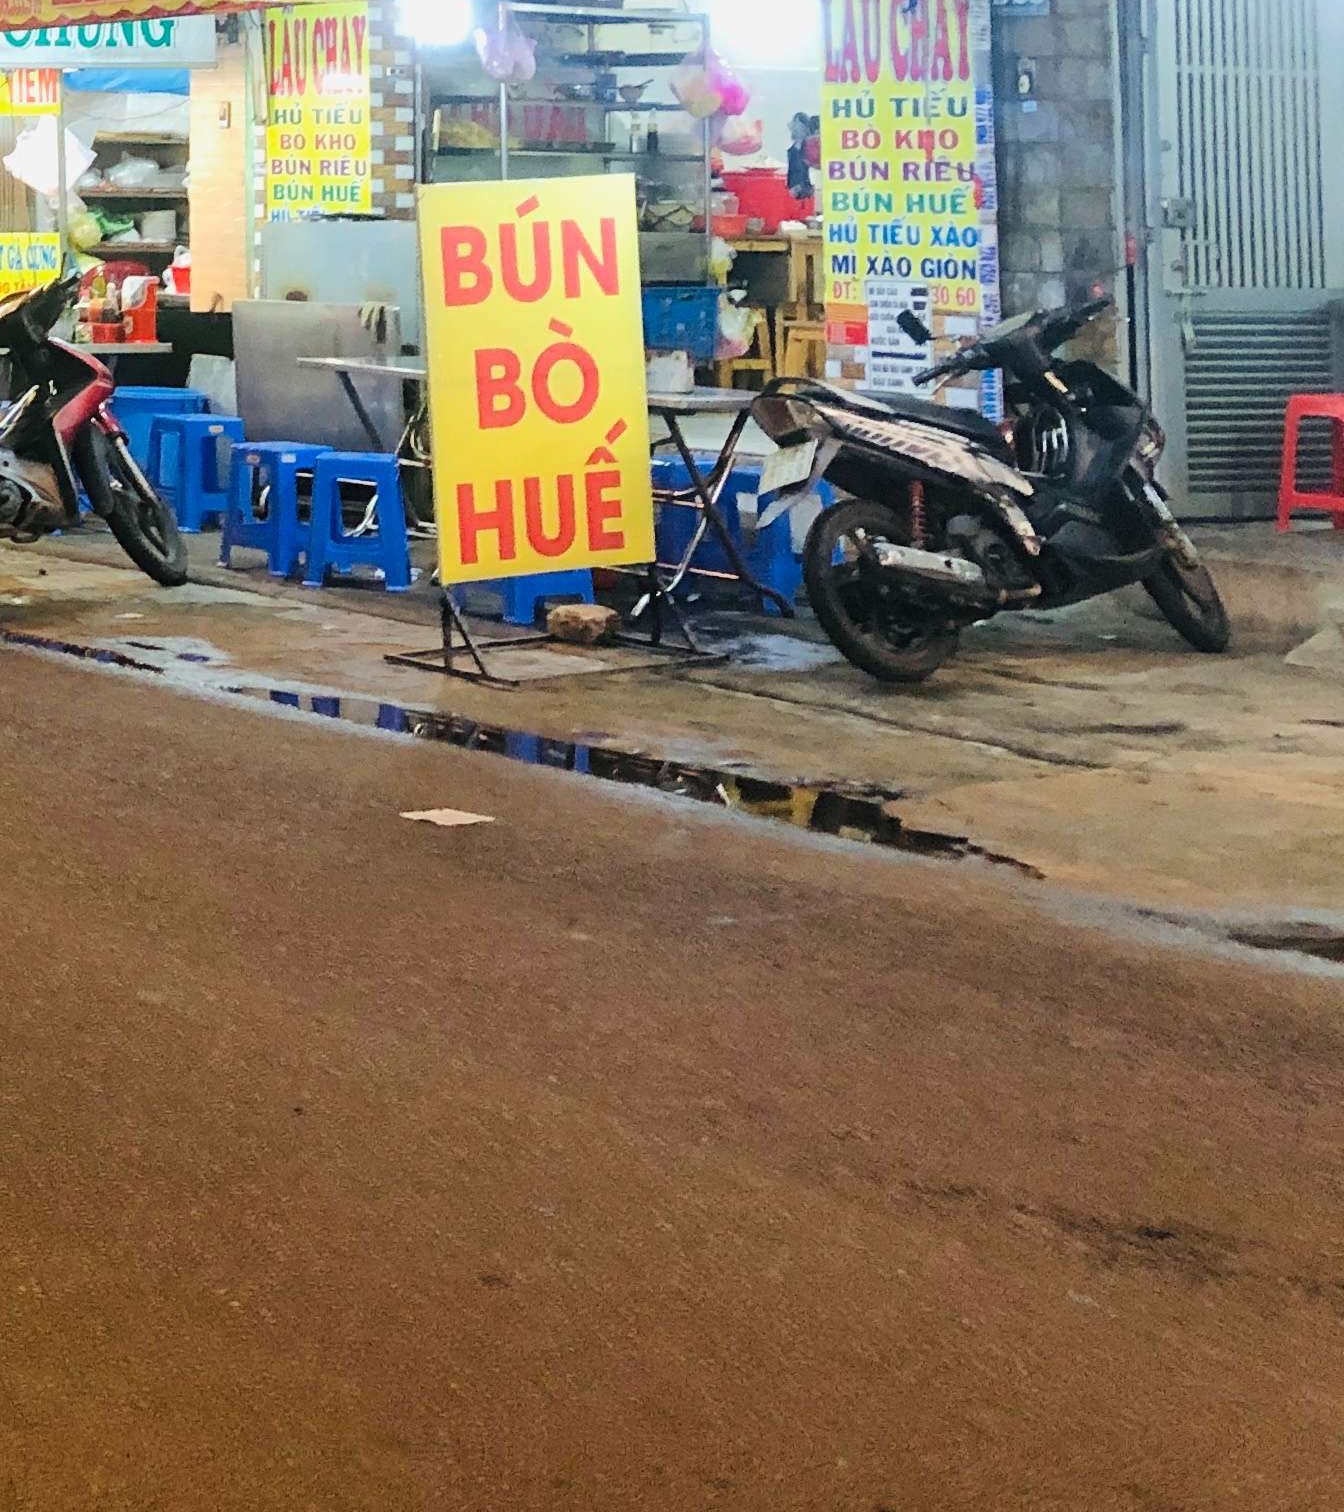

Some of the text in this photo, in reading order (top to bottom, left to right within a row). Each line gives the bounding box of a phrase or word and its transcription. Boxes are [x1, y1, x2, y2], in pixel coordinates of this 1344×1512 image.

[889, 87, 968, 118] TIẾU
[315, 133, 356, 151] KHO
[895, 128, 959, 150] KHO
[271, 154, 367, 177] BÚN RIÊU
[828, 155, 975, 182] BÚN RIÊU
[273, 179, 314, 201] BÚN
[831, 186, 970, 215] BÚN HUẾ
[829, 216, 858, 244] HỦ
[867, 216, 921, 246] TIẾU
[440, 195, 620, 307] BÚN
[920, 252, 977, 280] GIÒN
[956, 287, 976, 306] 60
[474, 317, 600, 430] BÒ
[455, 418, 628, 565] HUẾ
